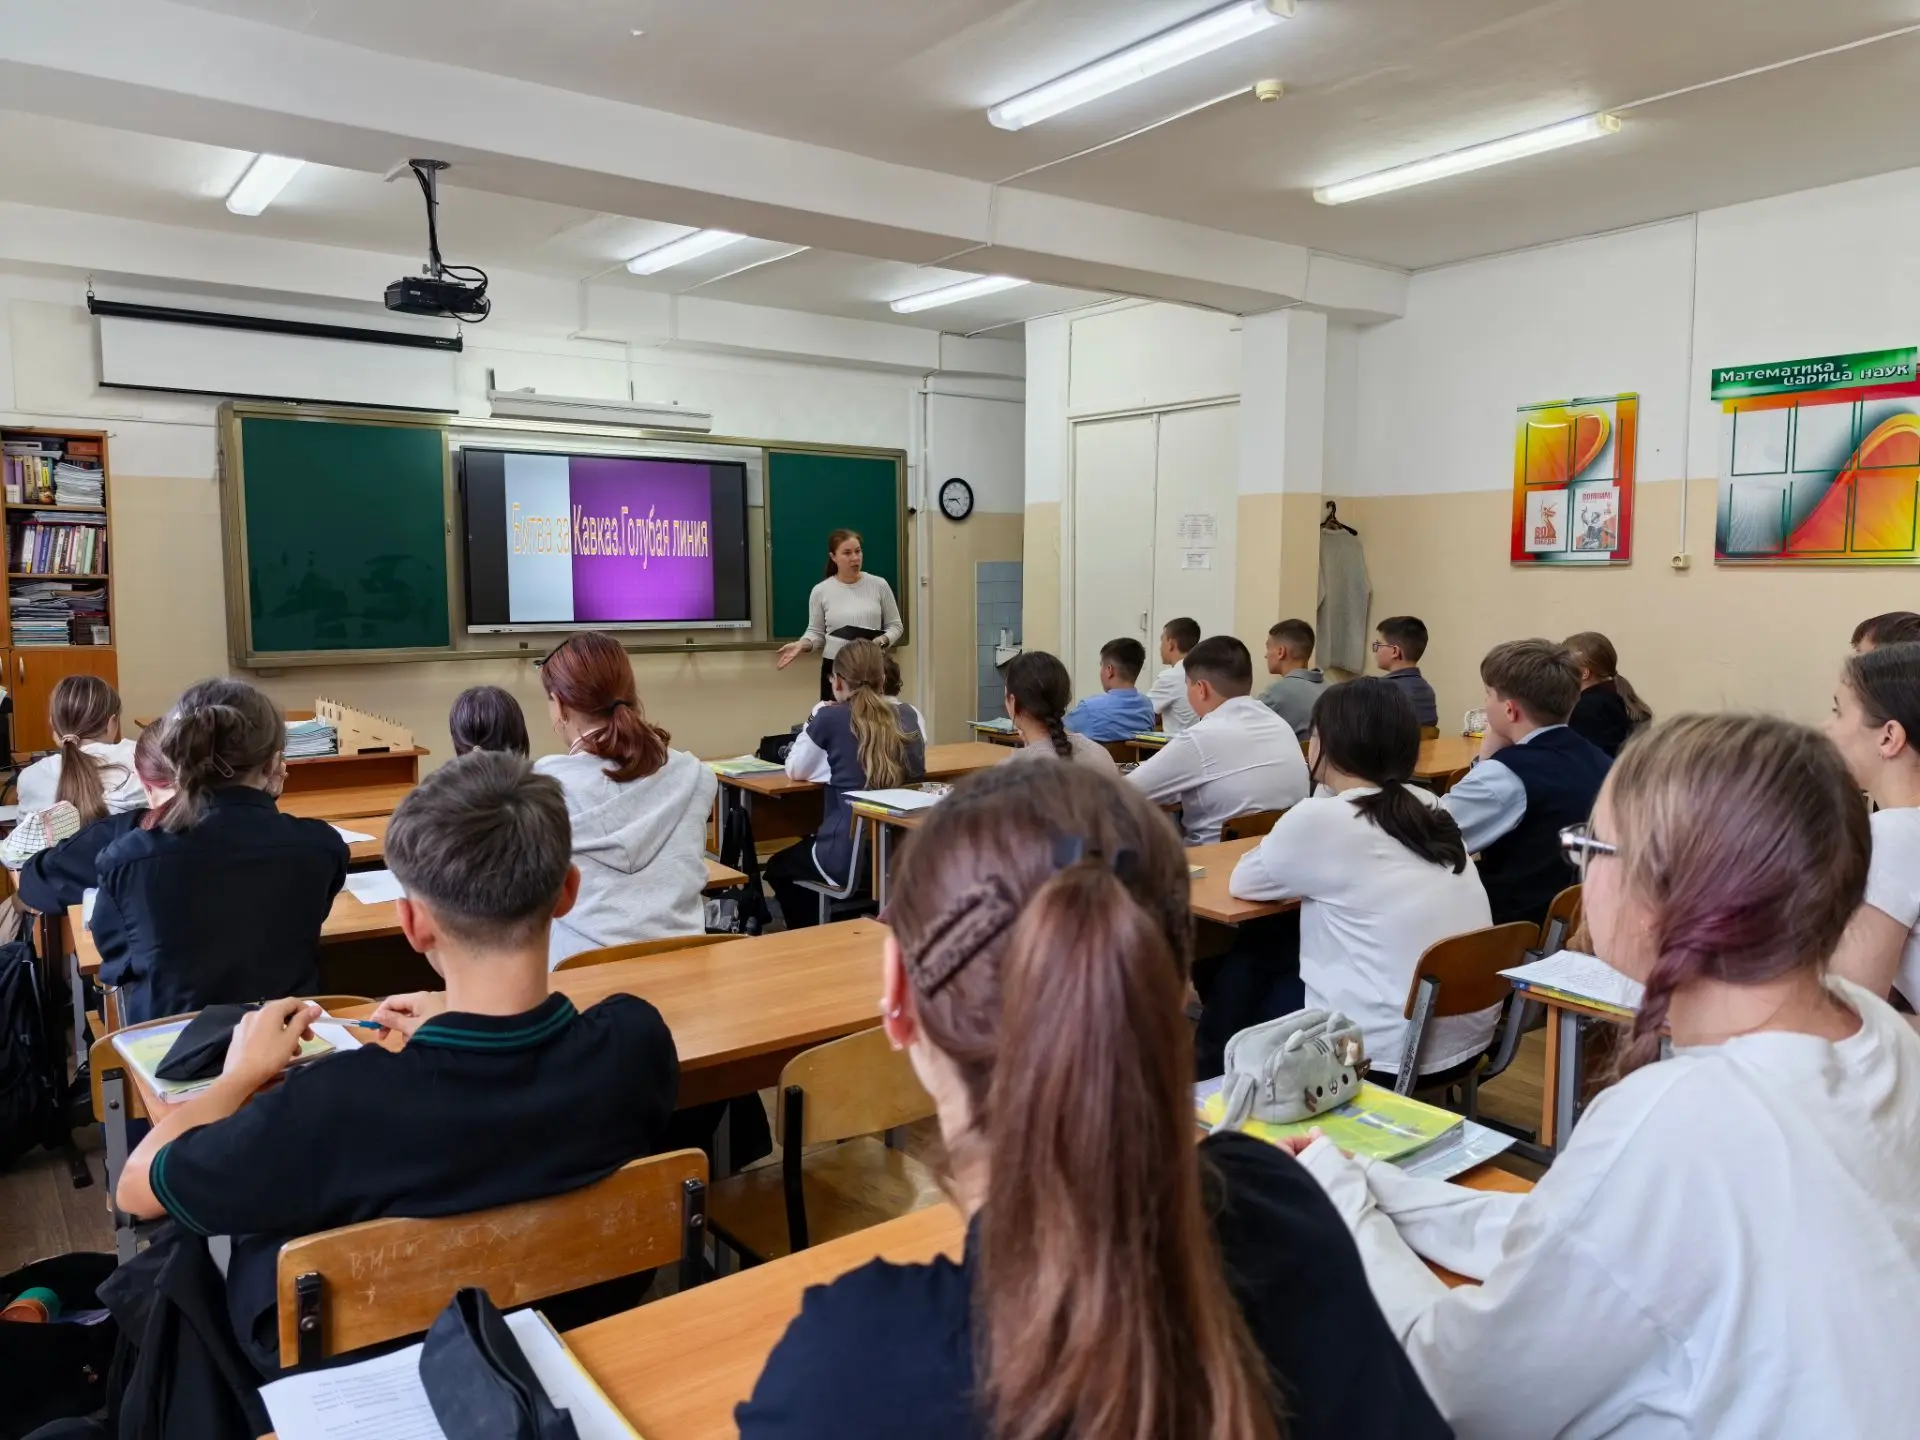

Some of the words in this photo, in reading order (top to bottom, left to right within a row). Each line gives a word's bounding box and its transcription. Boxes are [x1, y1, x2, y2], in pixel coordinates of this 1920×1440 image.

[1719, 362, 1835, 383] Математика
[1860, 363, 1910, 380] наук
[512, 502, 553, 555] Битва
[556, 517, 571, 554] за
[672, 519, 709, 558] линия
